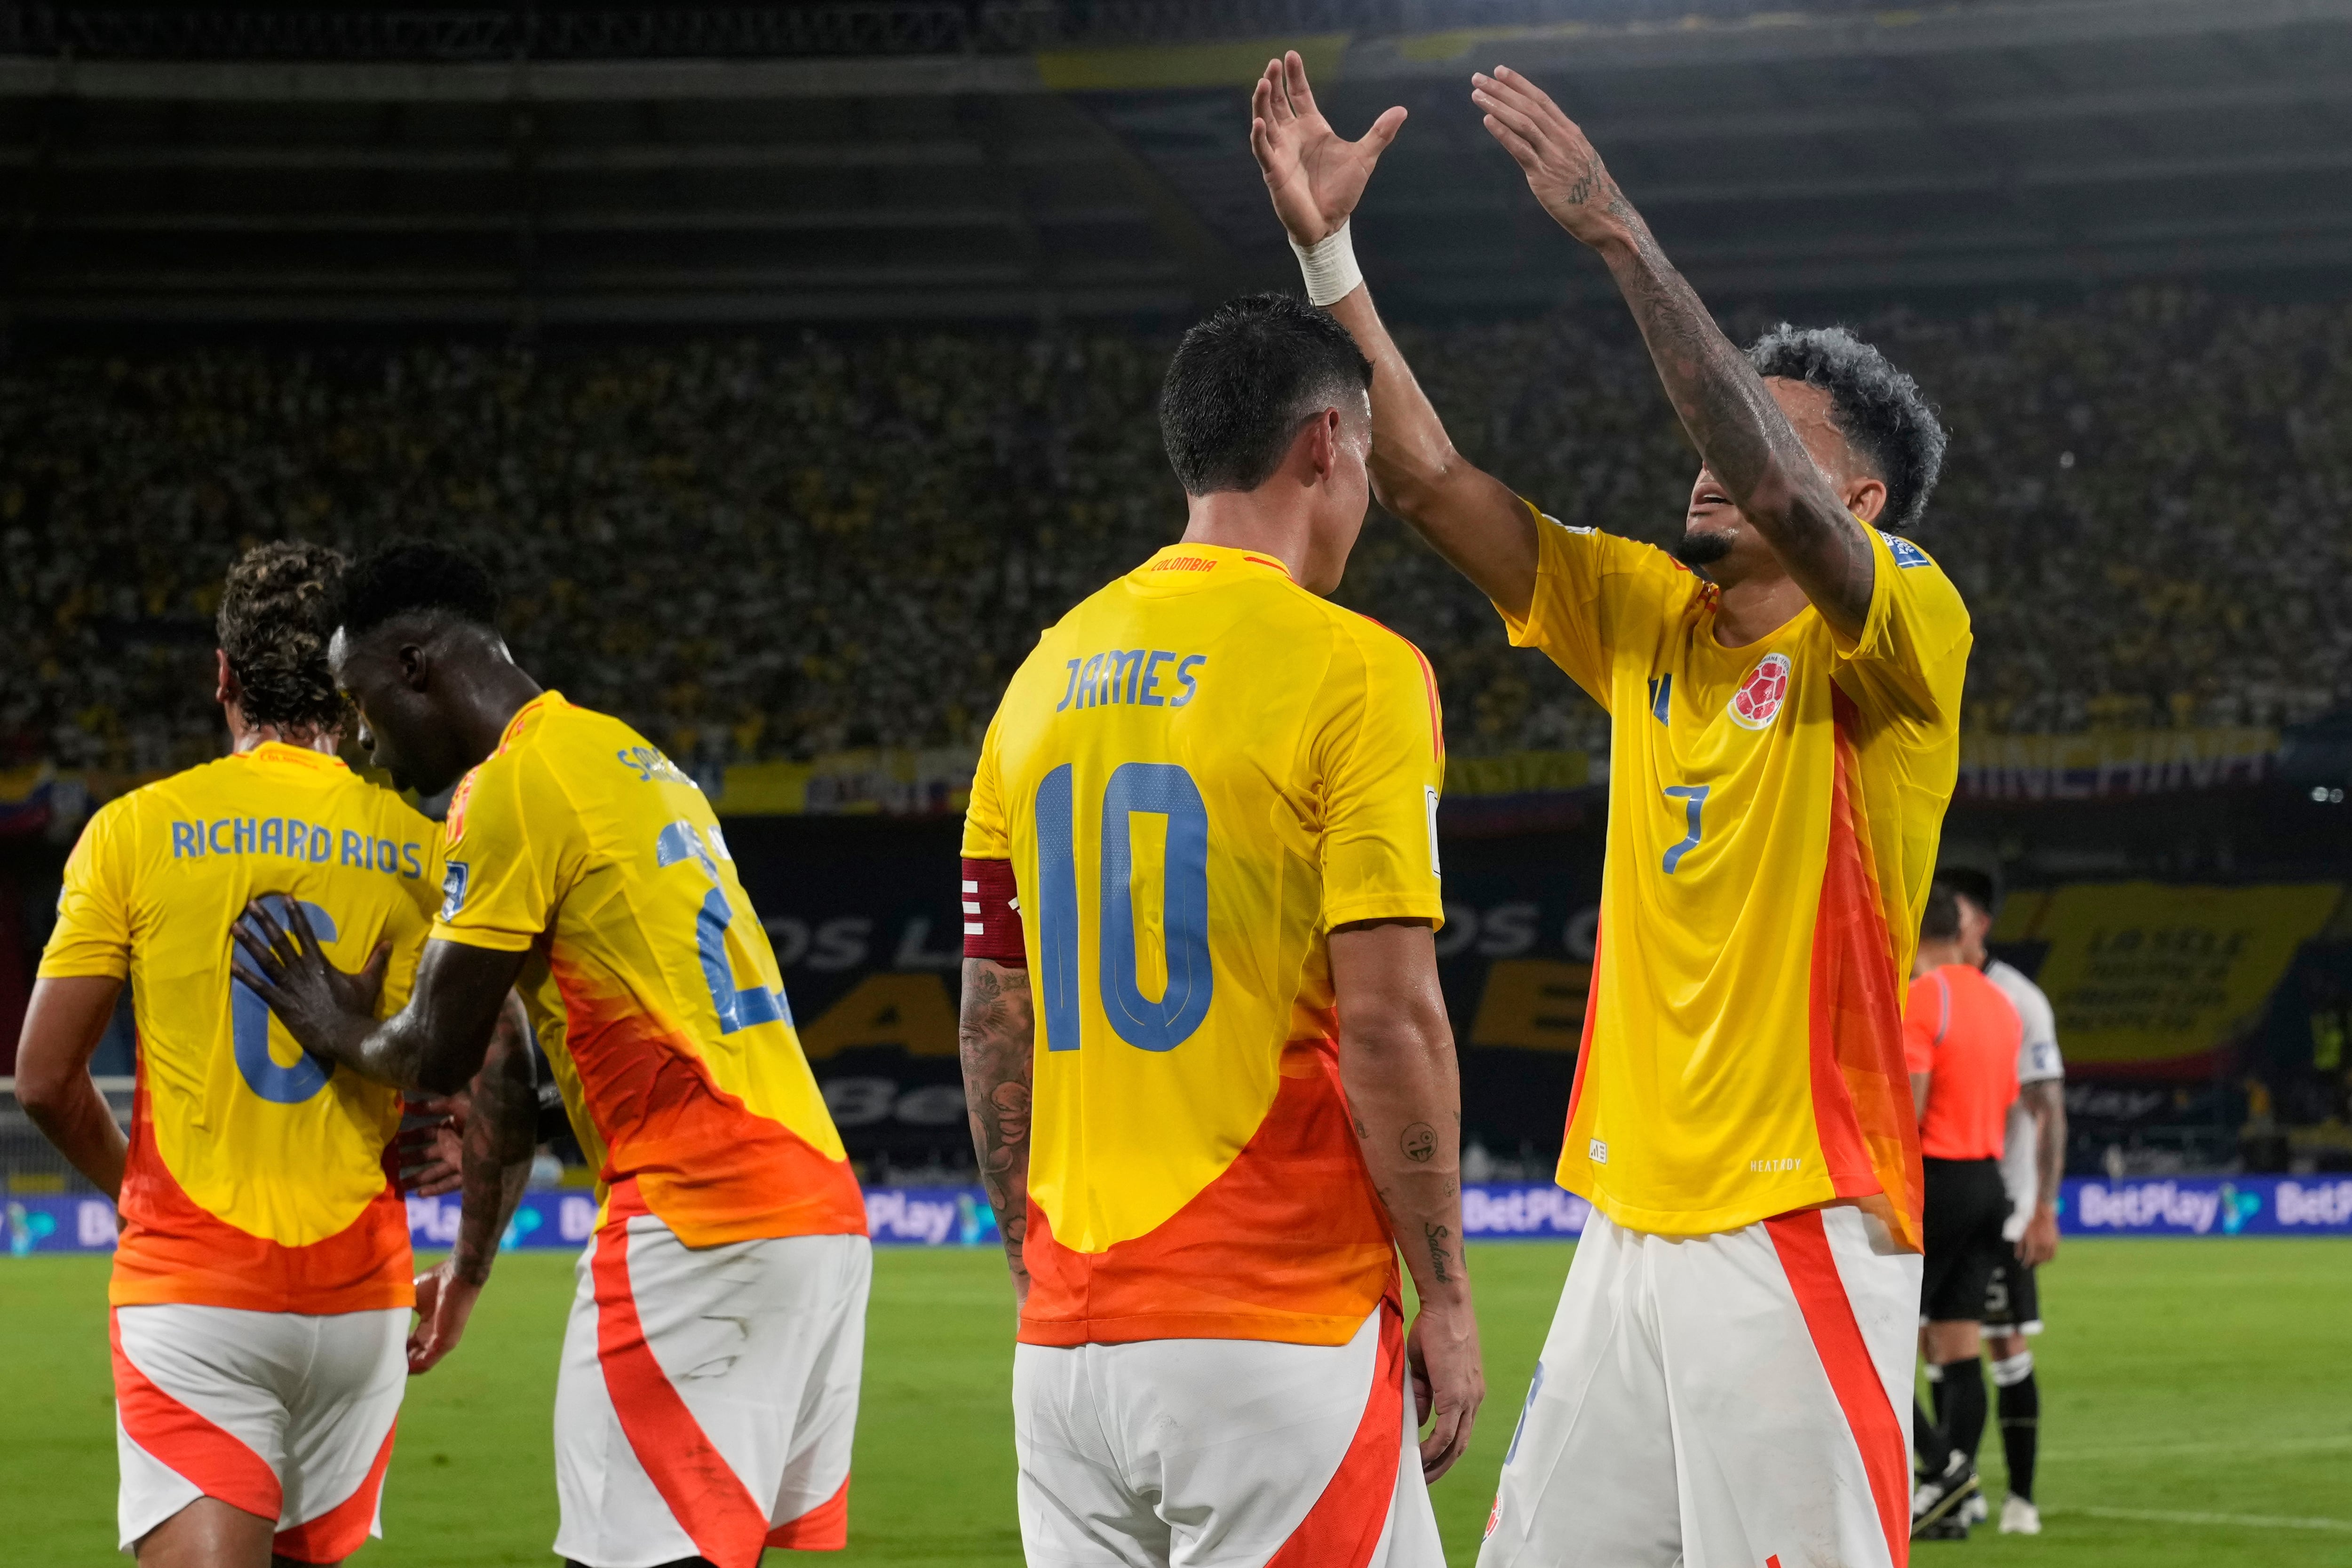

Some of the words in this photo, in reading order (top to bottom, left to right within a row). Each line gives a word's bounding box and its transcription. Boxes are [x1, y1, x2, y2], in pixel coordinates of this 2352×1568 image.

[1151, 556, 1218, 573] COLOMBIA
[1056, 649, 1208, 713] JAMES
[172, 817, 332, 863] RICHARD
[342, 828, 422, 879] RIOS
[1663, 785, 1710, 874] 7
[1035, 762, 1213, 1052] 10
[230, 894, 337, 1103] 6
[2079, 1180, 2220, 1234] BetPlay
